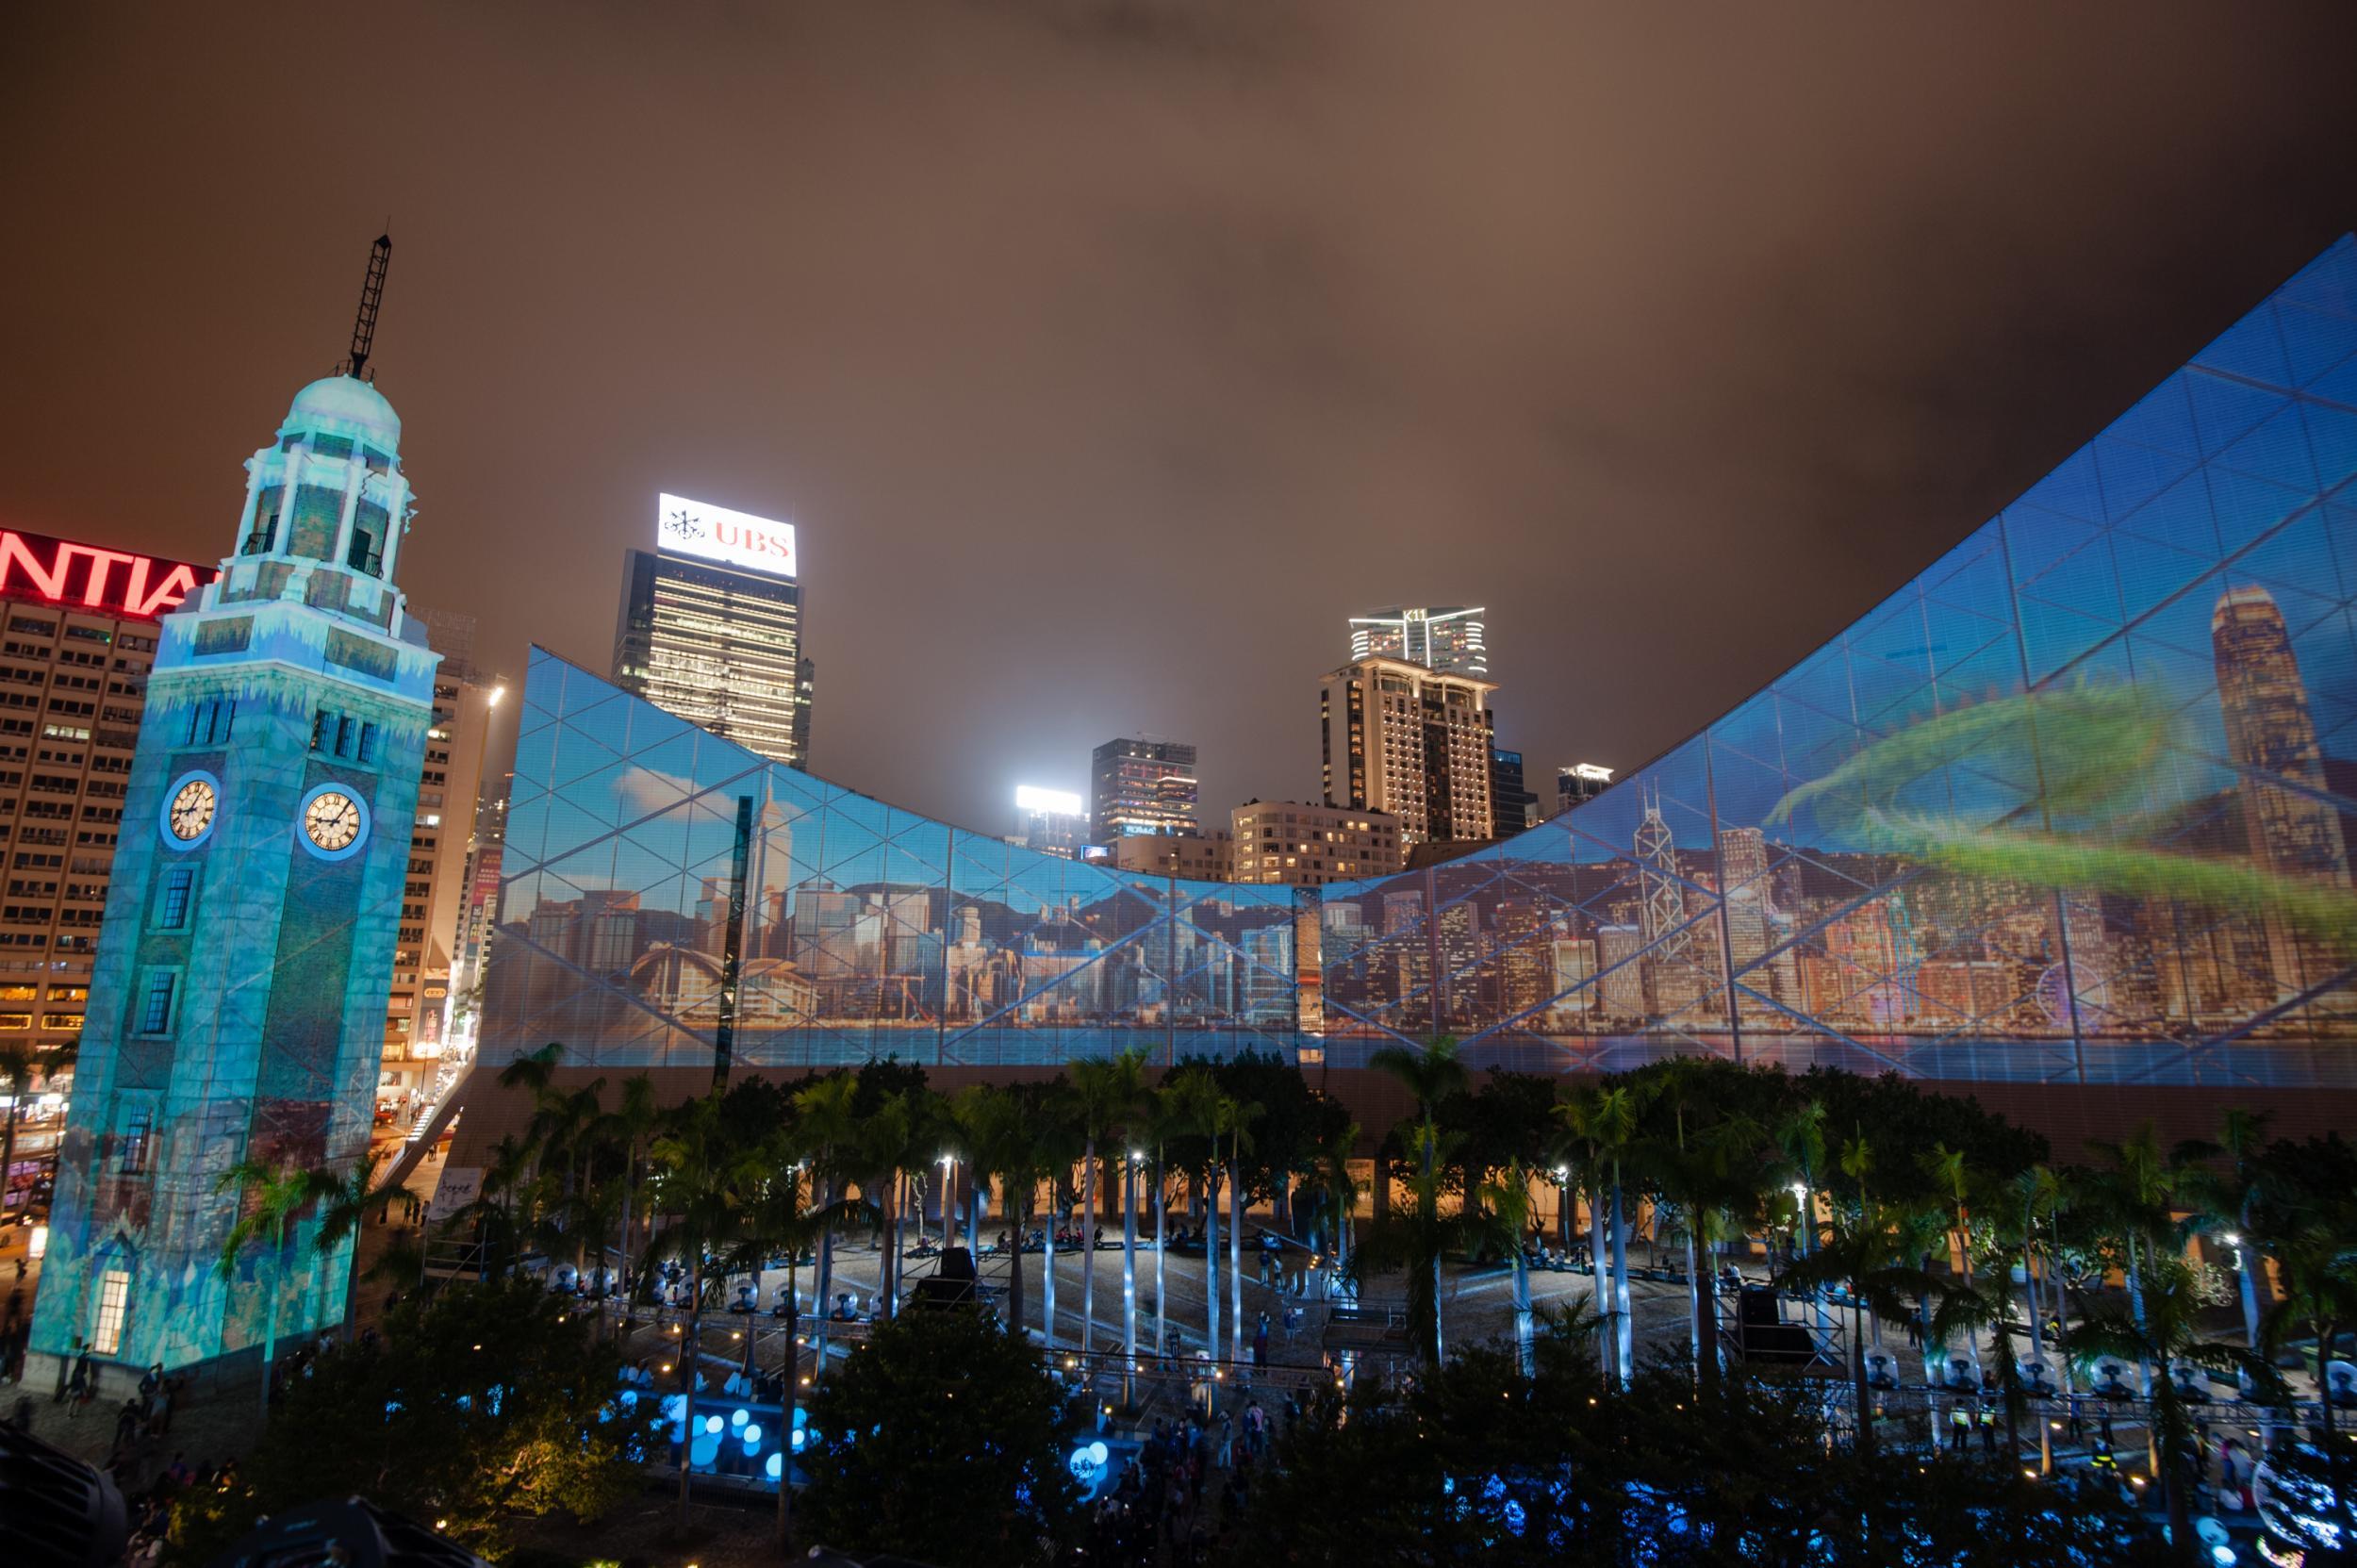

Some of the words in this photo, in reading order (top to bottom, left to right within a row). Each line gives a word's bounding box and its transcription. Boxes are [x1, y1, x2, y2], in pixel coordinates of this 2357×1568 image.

[717, 522, 789, 557] UBS
[0, 531, 223, 616] NTIA
[1403, 608, 1427, 622] K11
